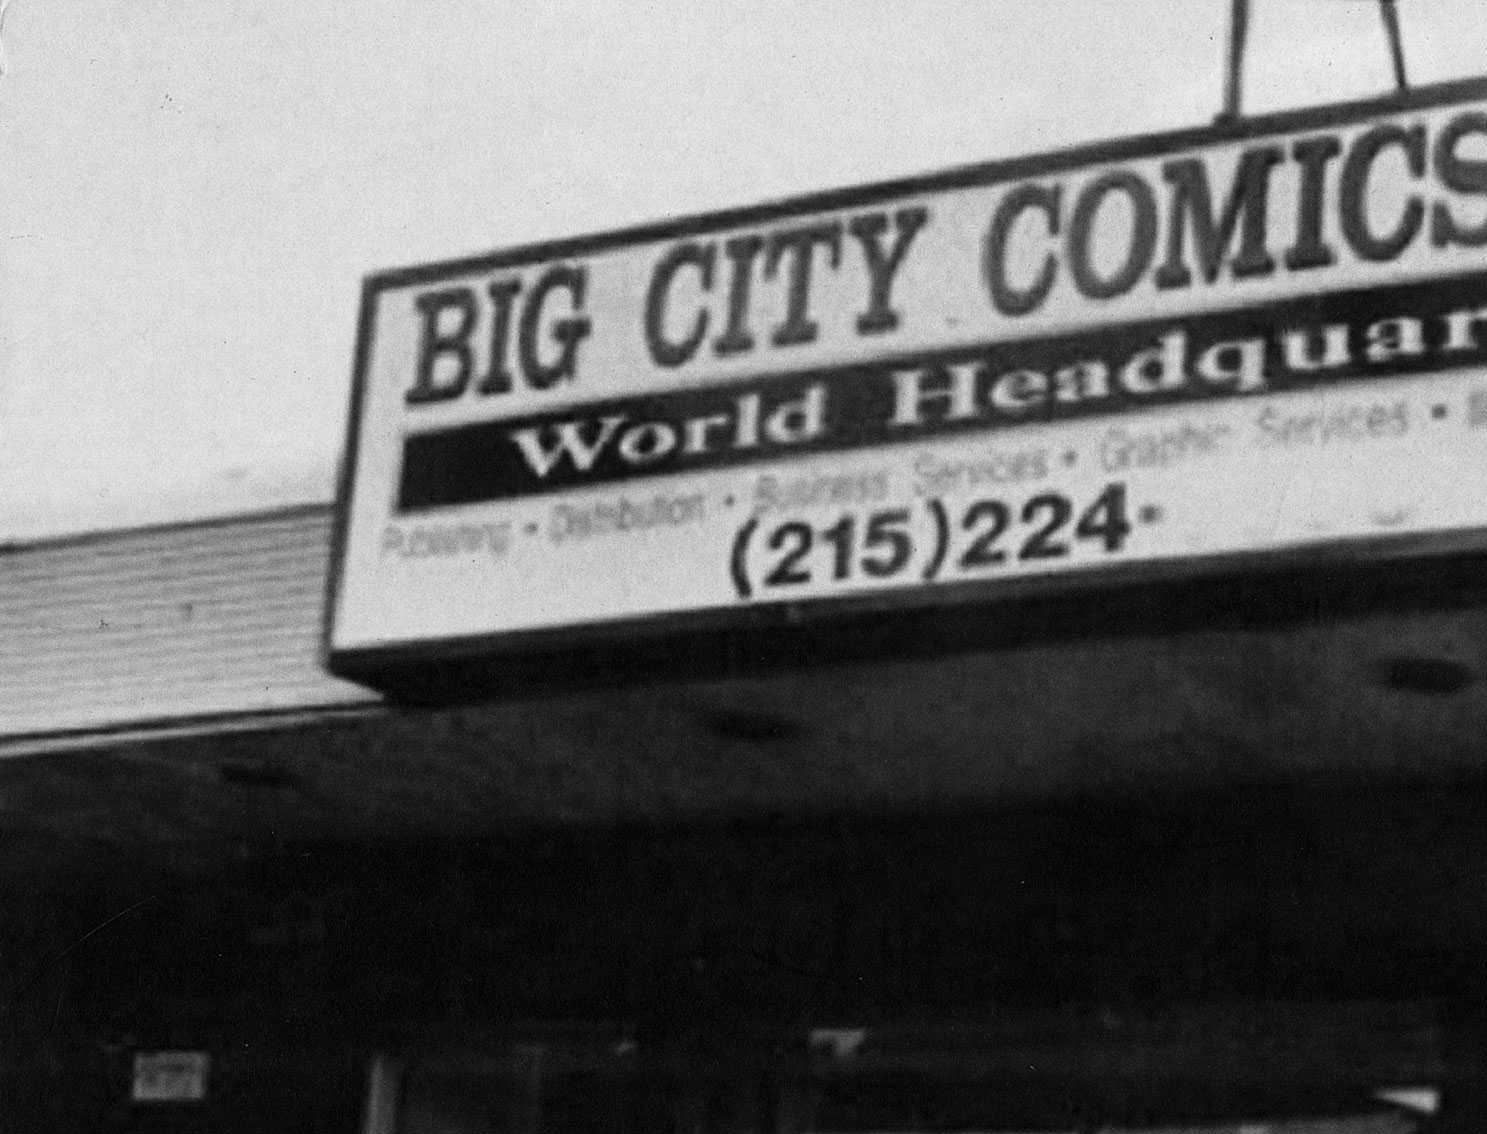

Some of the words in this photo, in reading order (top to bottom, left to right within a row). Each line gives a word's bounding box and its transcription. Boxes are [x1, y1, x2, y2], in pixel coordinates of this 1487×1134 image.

[405, 264, 592, 406] BIG
[644, 205, 927, 368] CITY
[510, 384, 828, 480] World
[914, 450, 1050, 500] Services
[1256, 402, 1408, 448] Services
